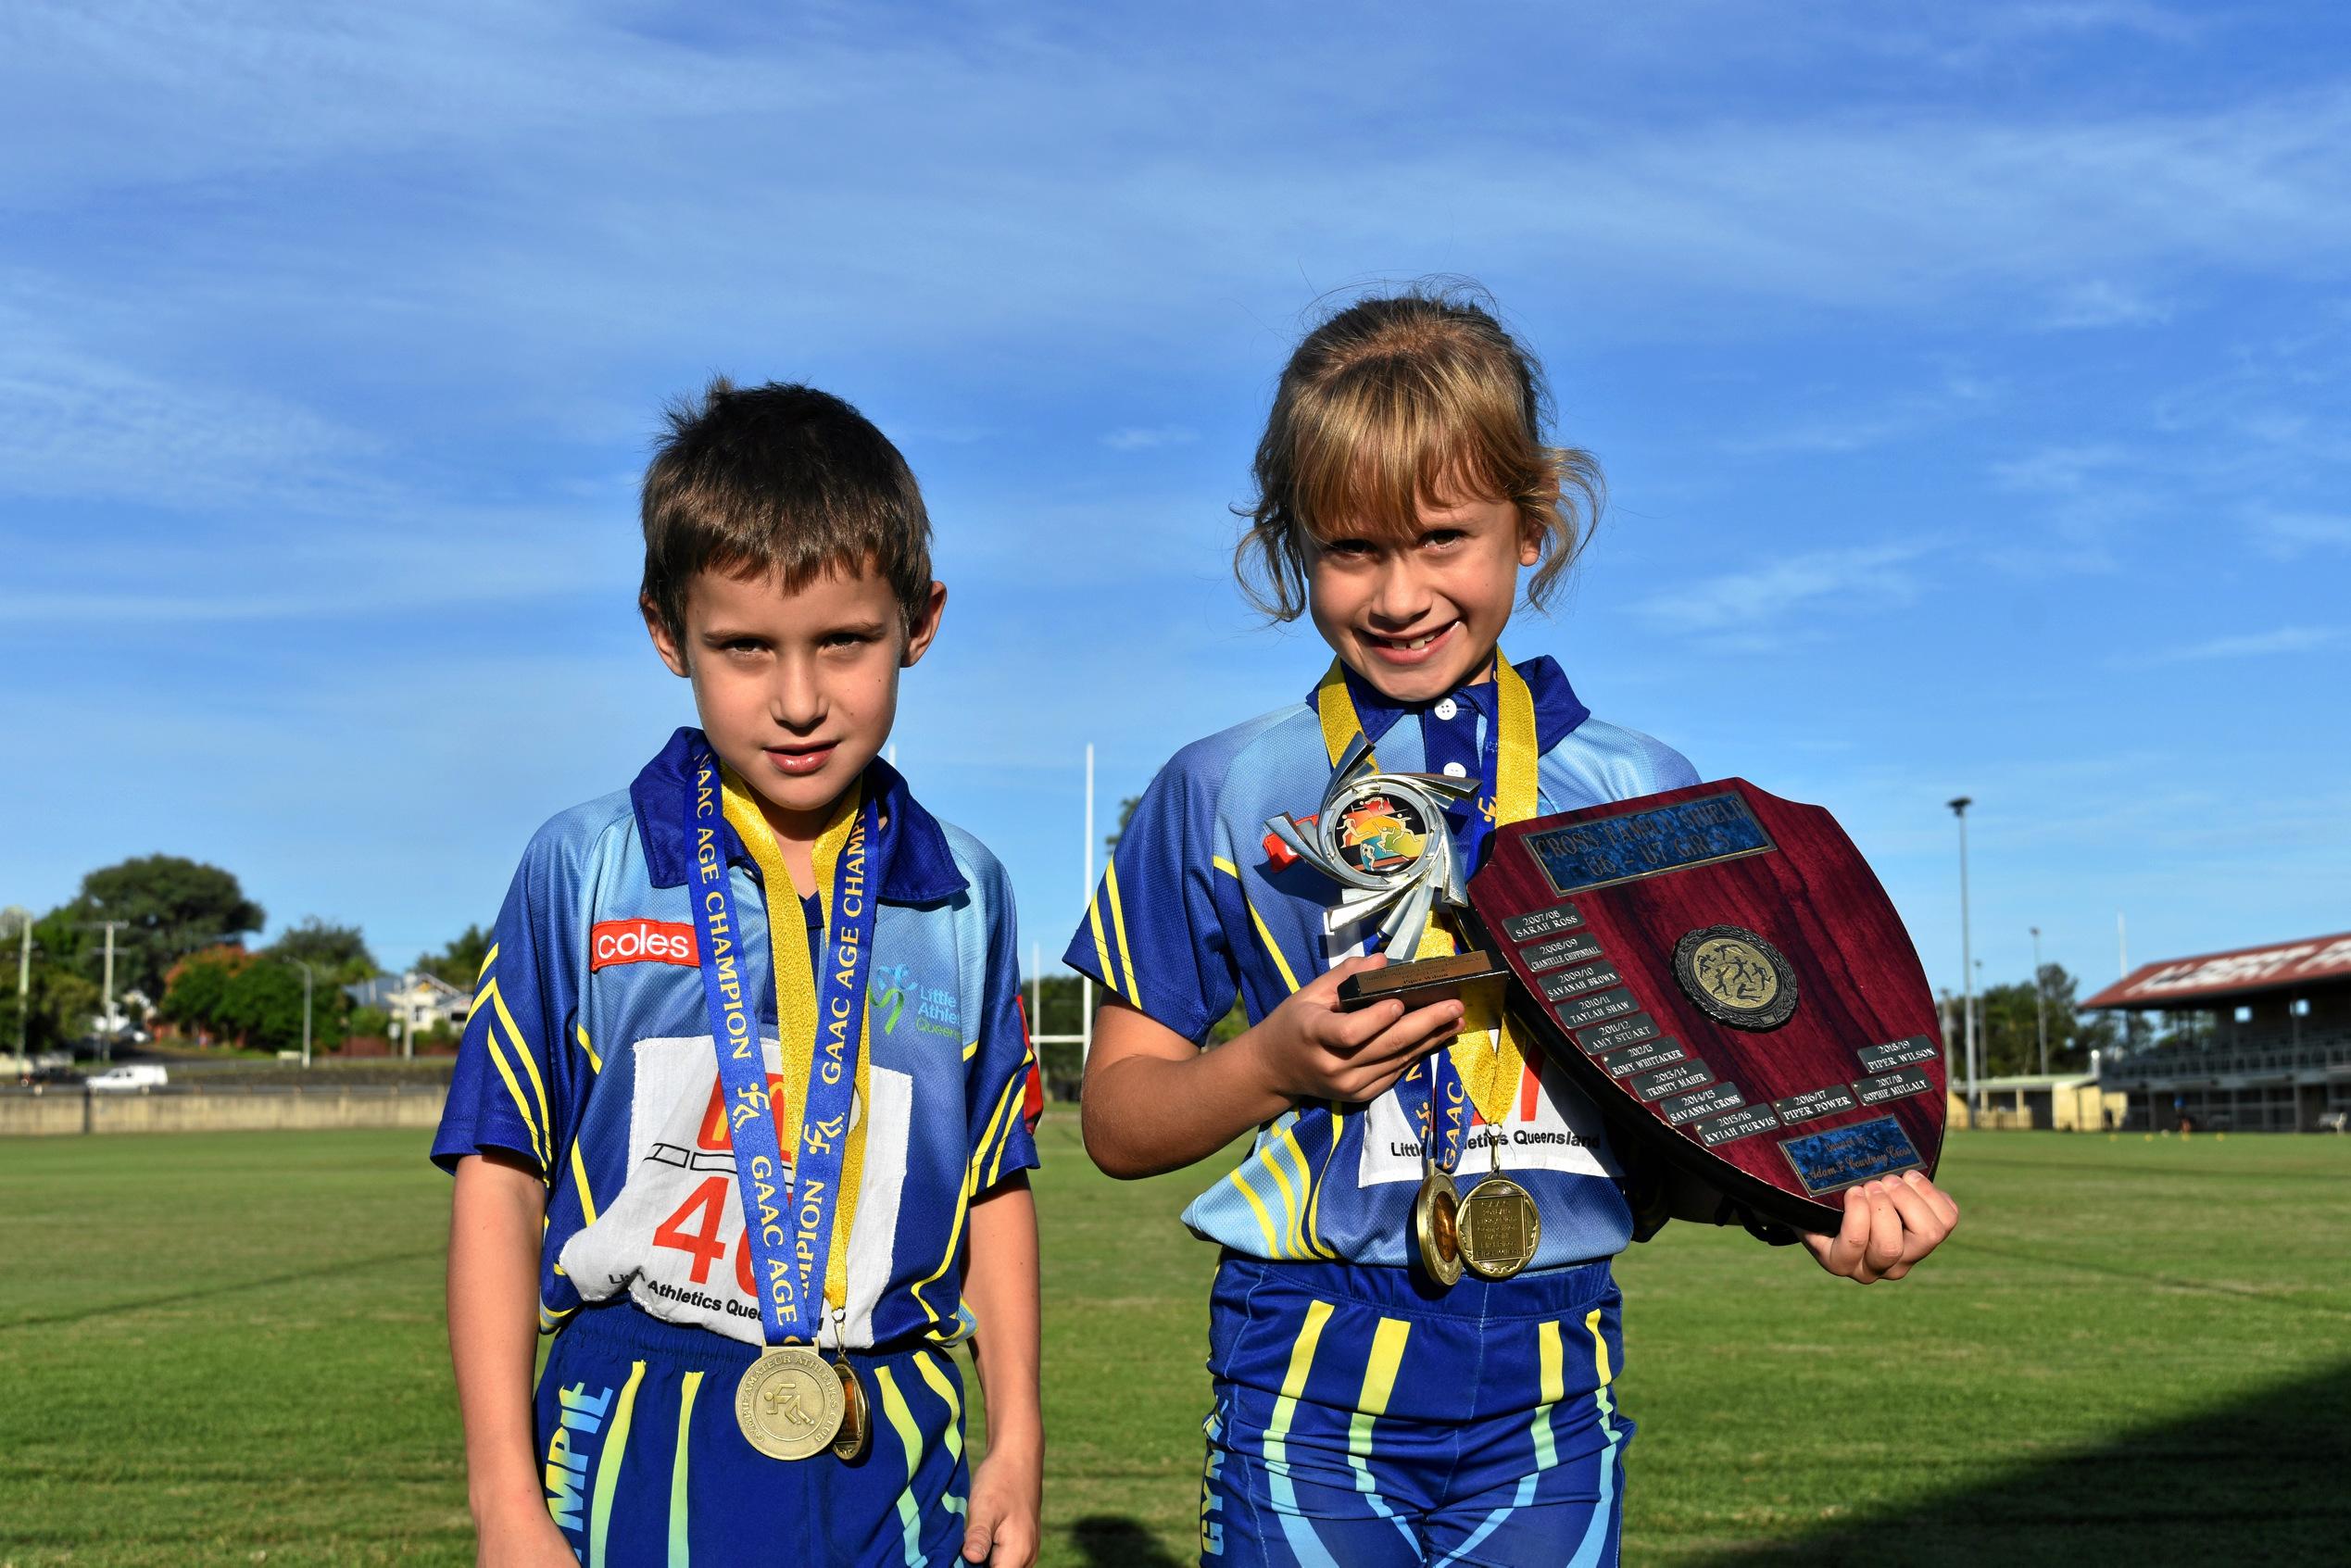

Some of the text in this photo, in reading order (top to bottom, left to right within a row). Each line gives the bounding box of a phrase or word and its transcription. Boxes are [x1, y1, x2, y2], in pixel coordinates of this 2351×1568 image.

[698, 828, 720, 884] AGE
[1535, 830, 1601, 860] CROSS
[1584, 853, 1617, 877] U6
[1639, 841, 1668, 865] U7
[1515, 915, 1578, 937] SARAH ROSS
[1522, 909, 1560, 925] 2007/08
[597, 923, 689, 960] coles
[1540, 938, 1578, 955] 2008/09
[1531, 955, 1565, 970] CHANTELLE
[705, 891, 752, 1060] CHAMPION
[1547, 972, 1616, 997] SAVANAH BROWN
[1558, 967, 1594, 983] 2009/10
[822, 997, 850, 1085] GAAC
[836, 926, 860, 990] AGE
[920, 985, 957, 1008] Little
[1578, 996, 1611, 1010] 2010/11
[1570, 1000, 1630, 1023] TAYLAH SHAW
[1592, 1025, 1653, 1050] AMY STUART
[1598, 1021, 1631, 1035] 2011/12
[1628, 1044, 1653, 1058] 2012/13
[1867, 1047, 1935, 1071] PIPER WILSON
[1877, 1040, 1910, 1054] 2018/19
[1612, 1049, 1684, 1076] ROMY WHITTACKER
[1645, 1073, 1707, 1098] TRINITY MAHER
[1653, 1067, 1688, 1084] 2013/14
[1876, 1074, 1904, 1087] 2017/18
[1681, 1089, 1716, 1107] 2014/15
[1792, 1089, 1827, 1106] 2016/17
[1862, 1079, 1928, 1102] SOPHIE MULLALY
[1669, 1094, 1741, 1123] SAVANNA CROSS
[1716, 1110, 1752, 1127] 2015/16
[1783, 1096, 1852, 1121] PIPER POWER
[1443, 1082, 1465, 1170] GAAC
[1704, 1116, 1777, 1143] KYIAH PURVIS
[1514, 1129, 1601, 1148] Queensland
[751, 1156, 798, 1325] GAAC AGE
[647, 1280, 722, 1311] Athletics
[745, 1355, 792, 1396] AMATEUR
[795, 1355, 838, 1410] ATHLETICS
[815, 1411, 838, 1443] CLUB
